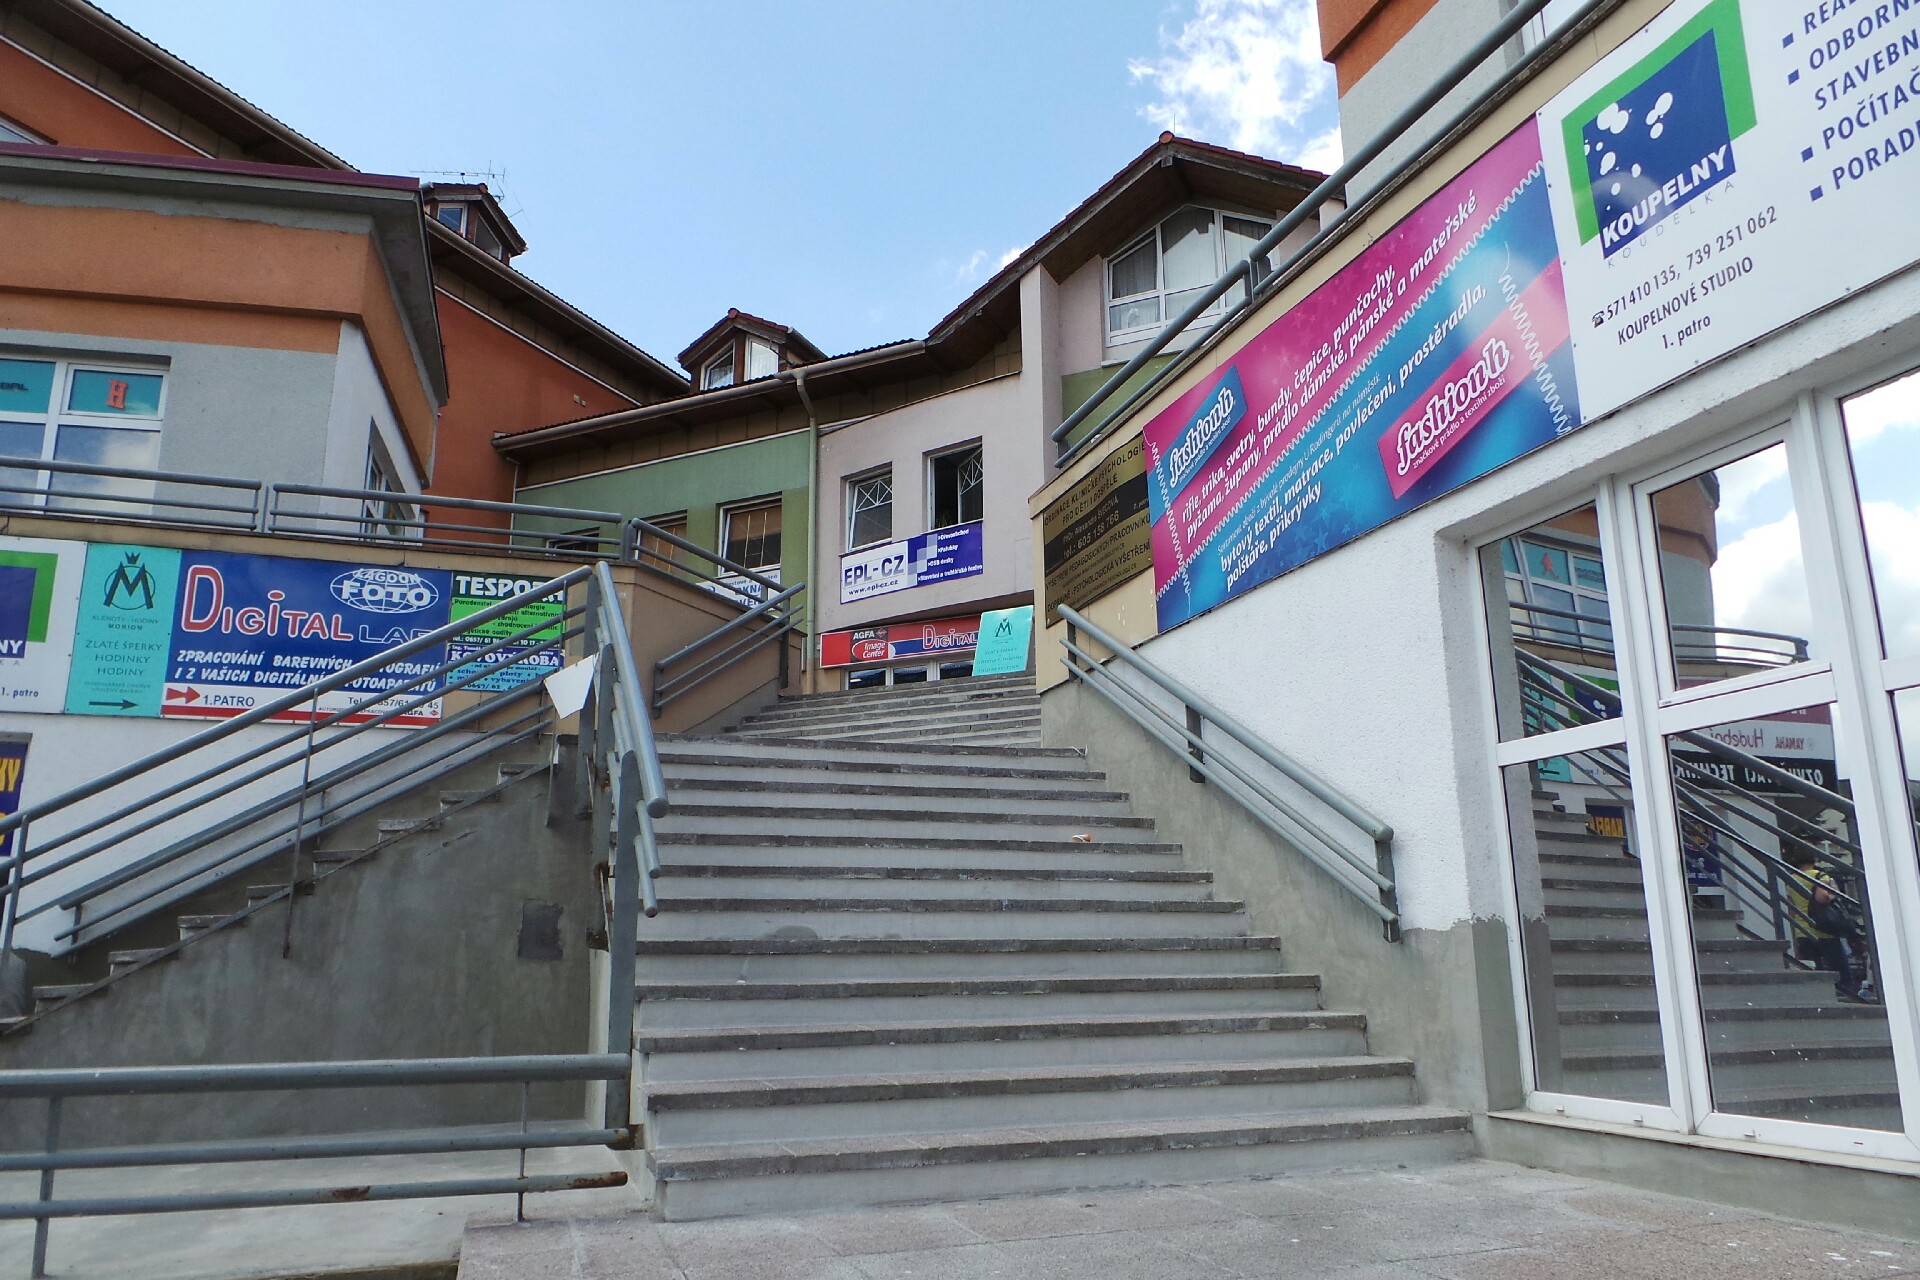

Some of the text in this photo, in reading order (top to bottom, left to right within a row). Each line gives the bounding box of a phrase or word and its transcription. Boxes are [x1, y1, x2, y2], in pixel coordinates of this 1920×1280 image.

[1809, 0, 1920, 70] ODBORN
[1603, 144, 1728, 249] KOUPELNY
[1686, 243, 1711, 271] 739
[1716, 225, 1743, 253] 251
[1747, 205, 1777, 234] 062
[1617, 256, 1753, 345] KOUPELNOVÉ STUDIO
[1677, 315, 1711, 347] patro
[1187, 189, 1478, 544] pyžama, župany, prádlo dámské, pánské a mateřské
[1181, 264, 1396, 524] rifle, trika, svetry, bundy, čepice, punčochy,
[1396, 337, 1510, 476] fashionh
[1221, 284, 1487, 572] bytový textil, matrace, povlečení, prostěradla,
[1412, 437, 1440, 469] značkové
[1439, 421, 1460, 446] prádlo
[1464, 394, 1488, 419] textilní
[1487, 374, 1506, 397] zboží
[1077, 532, 1091, 549] 605
[1226, 480, 1322, 593] polštáře, přikrývky
[353, 568, 421, 584] LAGOON
[843, 555, 905, 588] EPL-CZ
[341, 579, 431, 607] FOTO
[848, 579, 899, 596] www.epl-cz.cz
[85, 639, 163, 651] ZLATÉ ŠPERKY
[853, 632, 875, 641] AGFA
[864, 641, 886, 650] Image
[95, 653, 151, 664] HODINKY
[176, 650, 265, 666] ZPRACOVÁNÍ
[273, 655, 353, 671] BAREVNÝCH
[862, 649, 884, 659] Center
[97, 666, 145, 677] HODINY
[174, 667, 183, 679] I
[186, 667, 196, 679] Z
[201, 666, 251, 682] VAŠICH
[13, 687, 39, 699] patro
[204, 695, 255, 707] 1.PATRO
